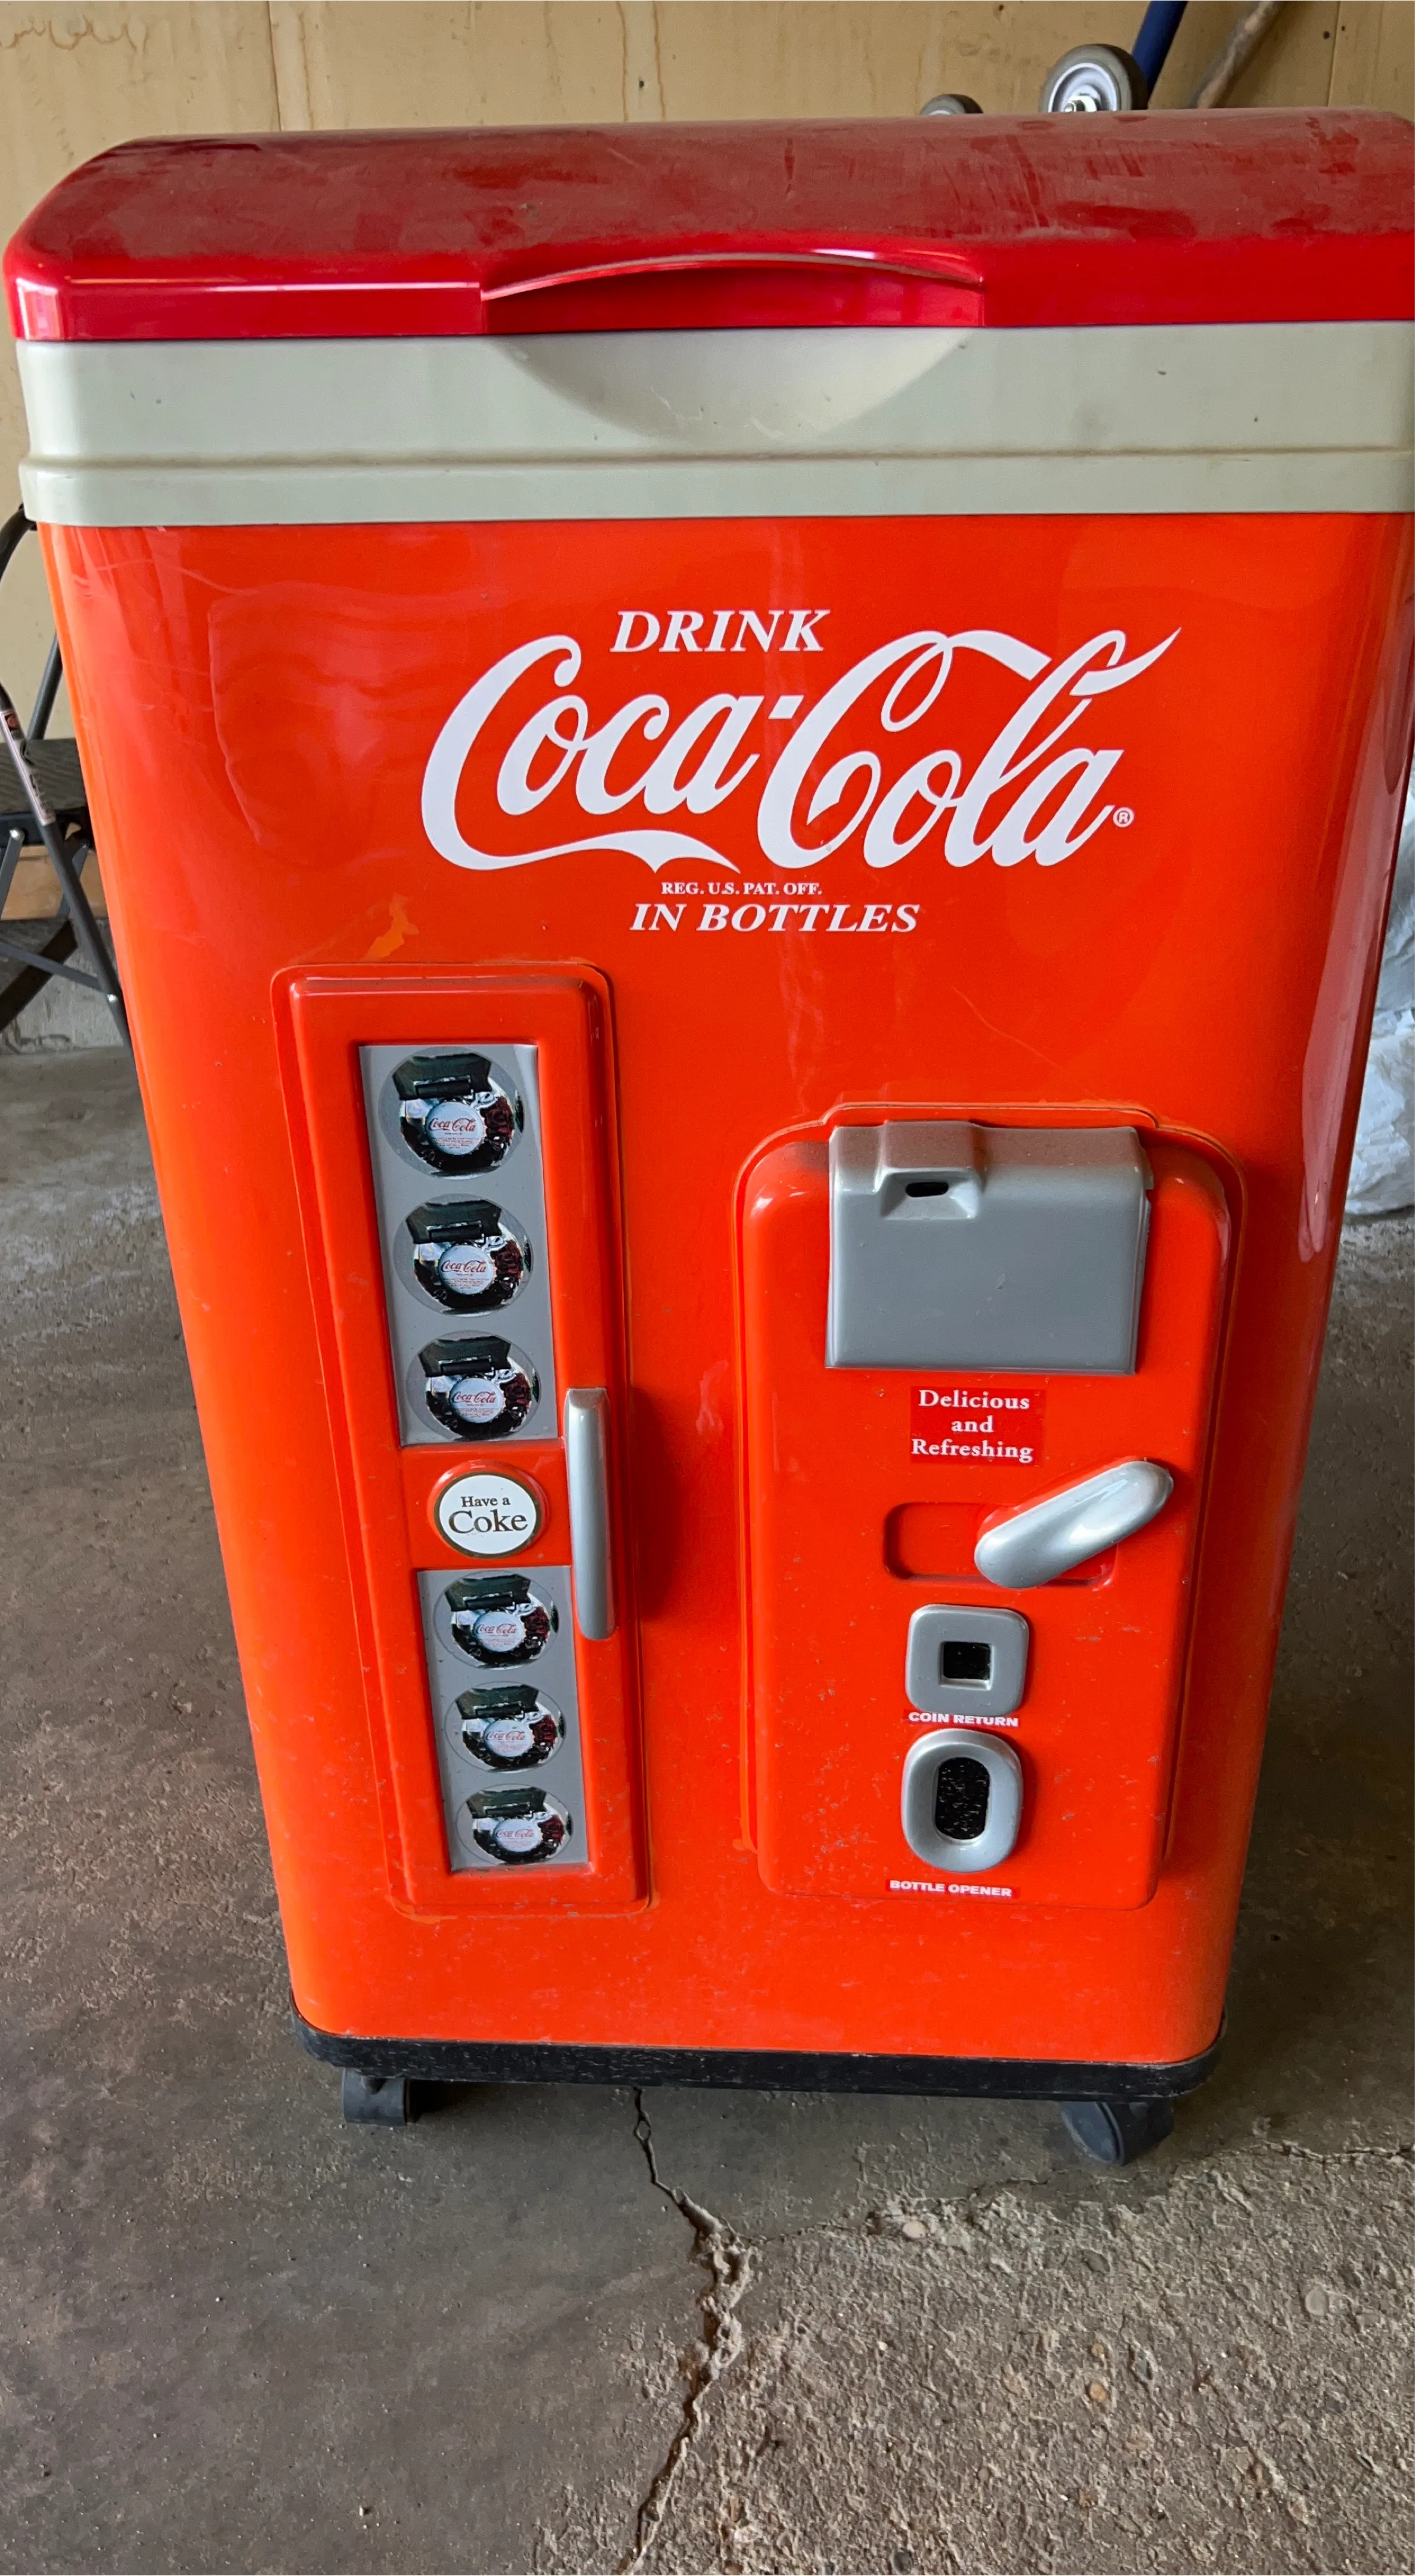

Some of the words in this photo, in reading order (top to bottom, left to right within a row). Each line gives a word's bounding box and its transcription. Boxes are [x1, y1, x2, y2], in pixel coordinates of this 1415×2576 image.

[610, 609, 831, 653] DRINK
[421, 627, 1181, 874] Coca-Cola
[661, 882, 705, 895] REG.
[708, 882, 740, 895] U.S.
[743, 882, 780, 895] PAT.
[783, 882, 822, 896] OFF.
[629, 903, 687, 931] IN
[696, 903, 920, 933] BOTTLES
[918, 1389, 1030, 1410] Delicious
[951, 1415, 994, 1433] and
[911, 1438, 1033, 1464] Refreshing
[460, 1496, 498, 1507] Have
[502, 1497, 511, 1506] a
[448, 1509, 528, 1534] Coke
[908, 1711, 949, 1723] COIN
[953, 1714, 1018, 1727] RETURN
[890, 1880, 945, 1893] BOTTLE
[948, 1884, 1012, 1897] OPENER
